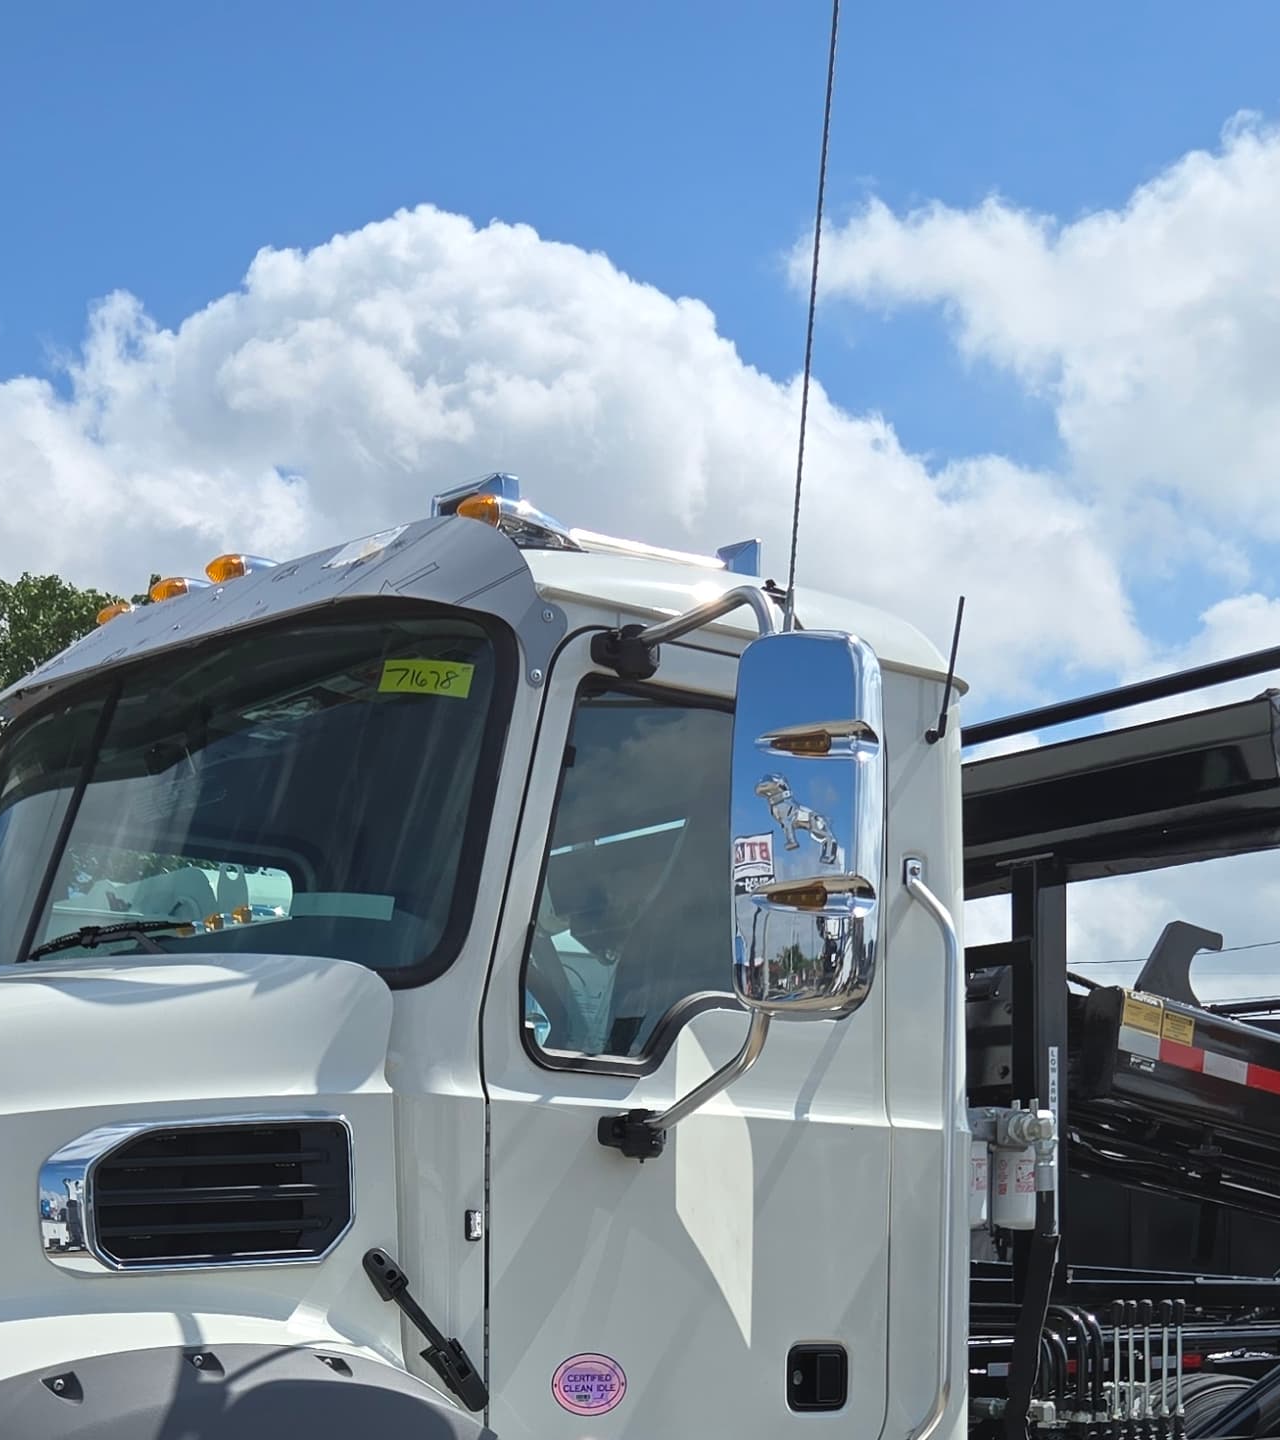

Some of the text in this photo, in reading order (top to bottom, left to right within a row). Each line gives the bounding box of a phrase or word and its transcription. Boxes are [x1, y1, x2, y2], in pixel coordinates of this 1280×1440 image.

[386, 667, 459, 690] 71678
[567, 1374, 612, 1382] CERTIFIED
[563, 1384, 616, 1392] CLEAN IDLE
